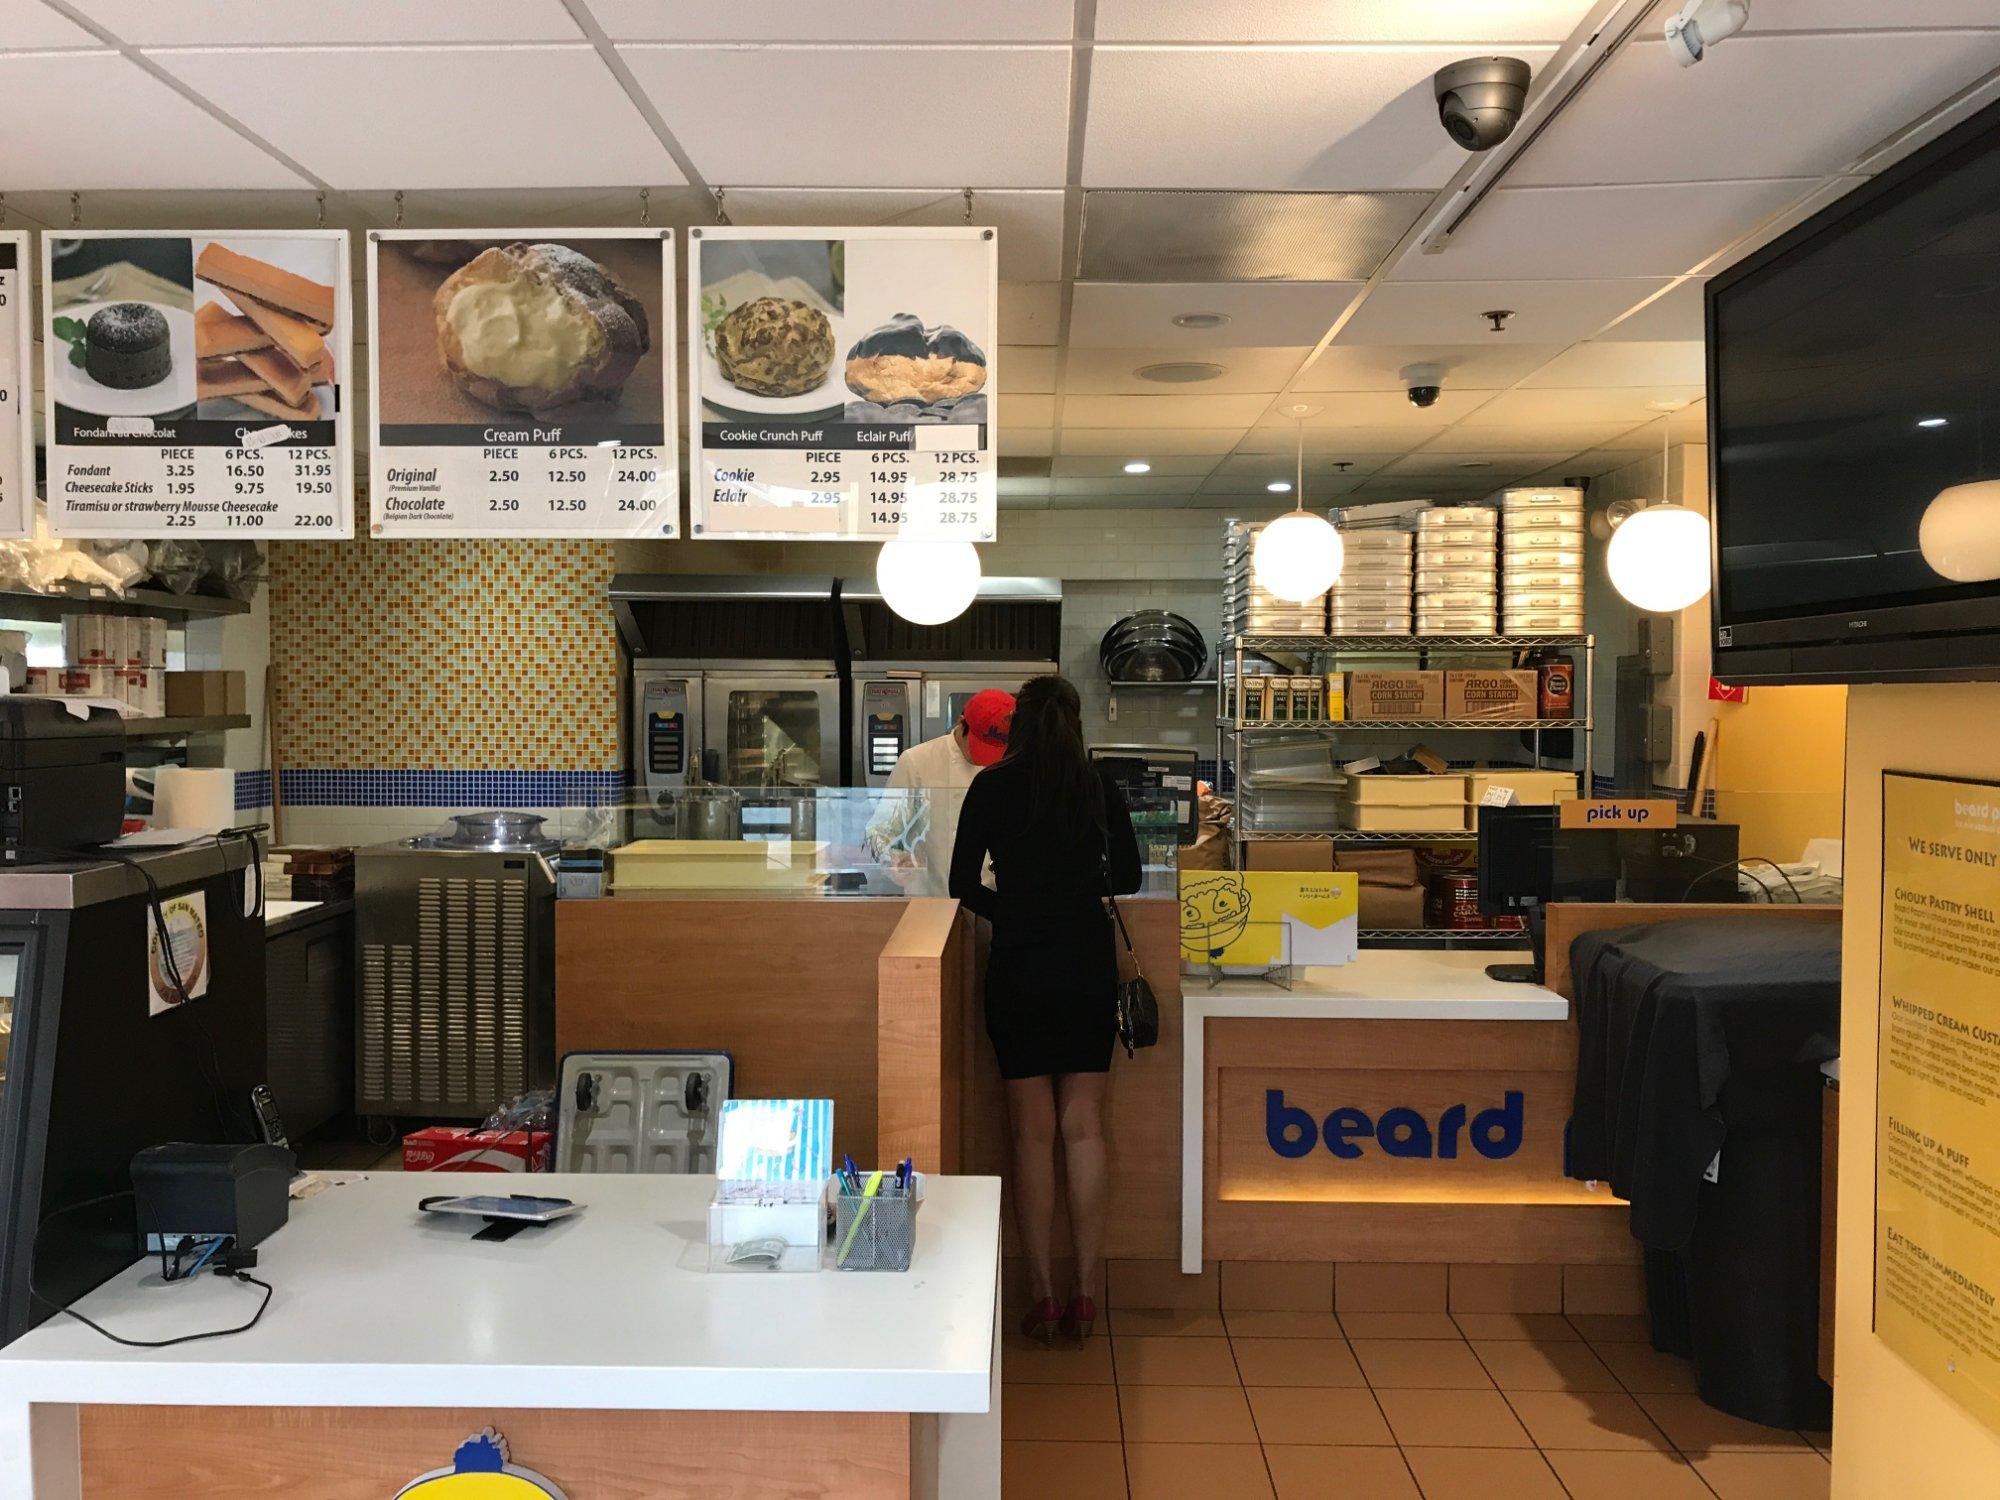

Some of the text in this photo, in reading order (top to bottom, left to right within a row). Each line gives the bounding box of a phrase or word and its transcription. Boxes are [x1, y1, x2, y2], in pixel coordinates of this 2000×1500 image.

[484, 428, 562, 442] Cream Puff
[720, 430, 823, 442] Cookie Crunch Puff
[856, 430, 884, 442] Eclair
[161, 449, 331, 460] PIECE 6 PCS. 12 PCS.
[483, 448, 657, 459] PIECE 6 PCS. 12 PCS.
[806, 452, 980, 463] PIECE 6 PCS. 12 PCS.
[67, 465, 331, 476] Fondant 3.25 16.50 31.95
[387, 468, 656, 485] Original 2.50 12.50 24.00
[714, 468, 977, 483] Cookie 2.95 14.95 28.75
[65, 482, 332, 494] Cheesecake Sticks 1.95 9.75 19.50
[713, 489, 977, 504] Eclair 2.95 14.95 28.75
[66, 500, 278, 514] Tiramisu or strawberry Mousse Cheesecake
[385, 497, 656, 511] Chocolate 2.50 12.50 24.00
[166, 515, 332, 527] 2.25 11.00 22.00
[870, 512, 977, 524] 14.95 28.75
[1371, 680, 1404, 689] ARGO
[1465, 679, 1498, 689] ARGO
[1372, 690, 1423, 699] CORN STARCH
[1466, 690, 1517, 698] CORN STARCH
[1586, 805, 1649, 823] pick up
[1908, 837, 1997, 868] WE SERVE ONLY
[1894, 887, 1927, 908] CHOUX
[1929, 894, 1963, 917] PASTRY
[1964, 902, 1995, 924] SHELL
[1892, 995, 1935, 1023] WHIPPED
[1936, 1012, 1970, 1037] CREAM
[1266, 1089, 1525, 1160] beard
[1888, 1116, 1970, 1168] FILLING UP A PUFF
[1887, 1226, 1996, 1308] EAT THEM IMMEDIATELY
